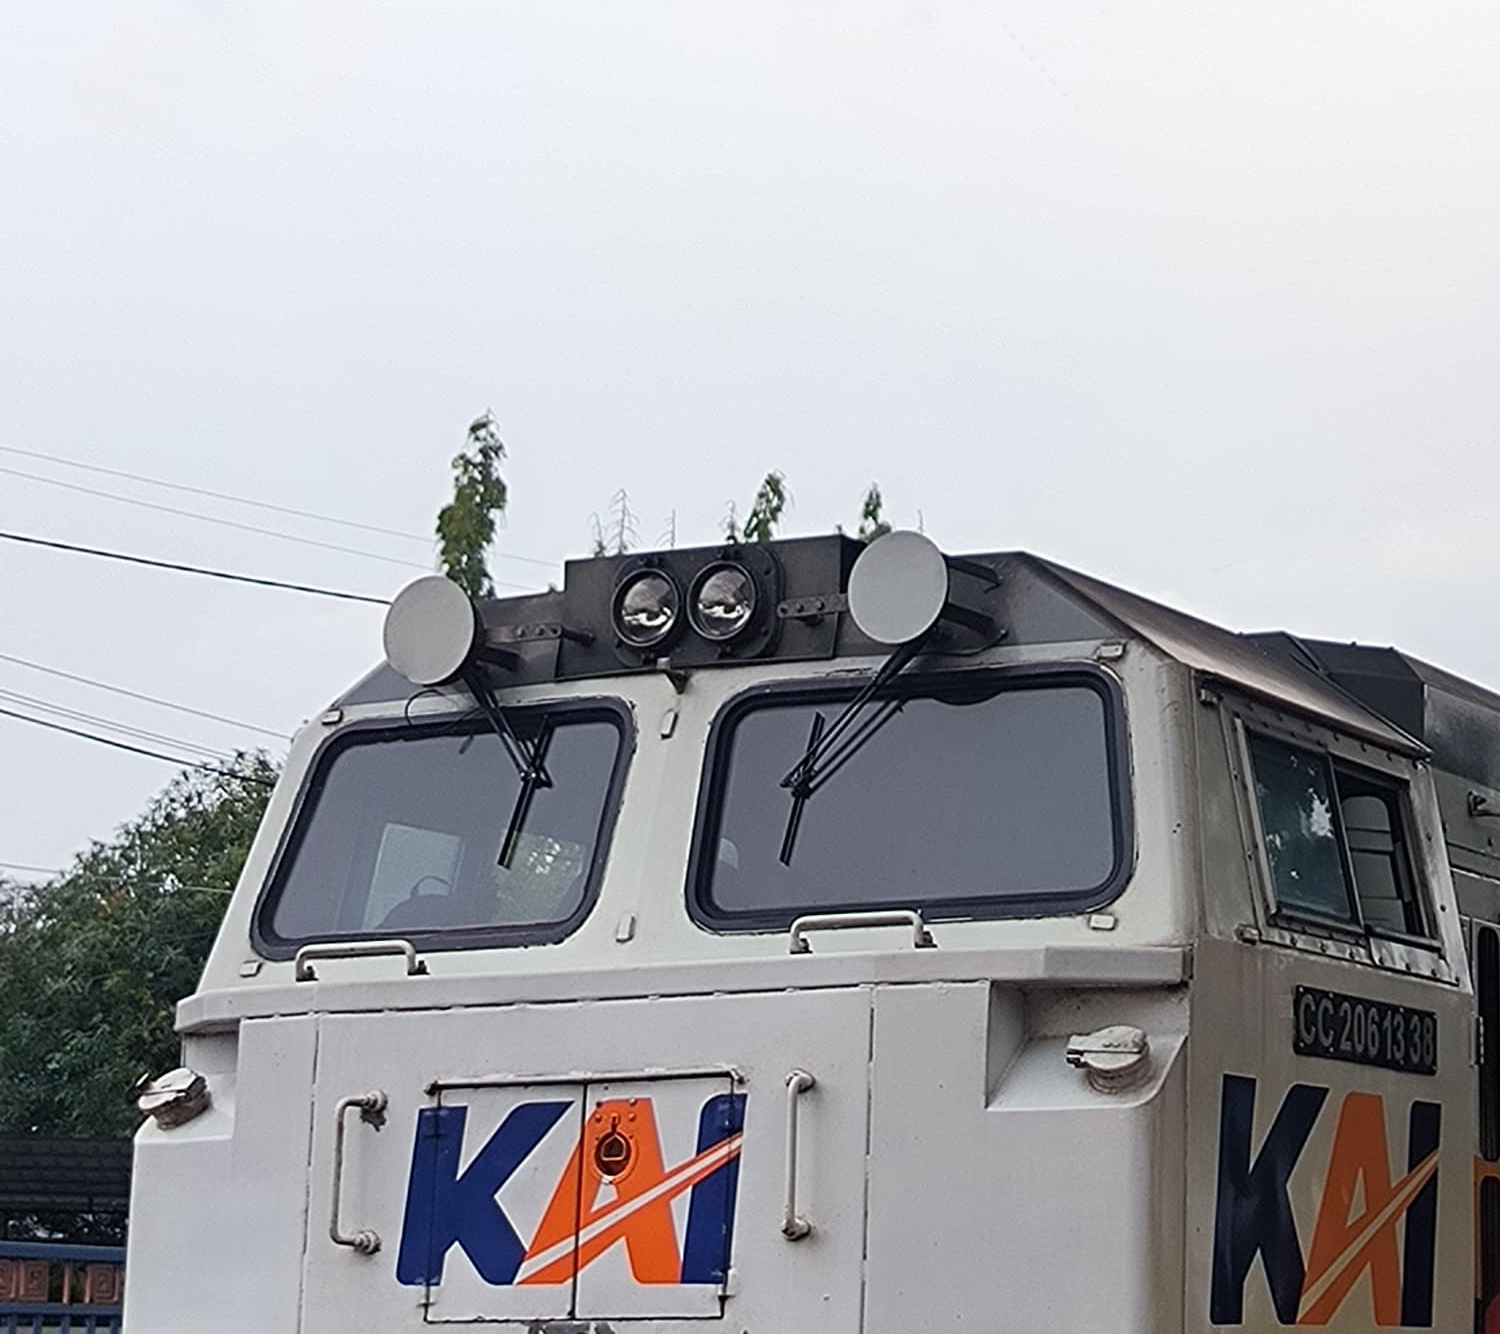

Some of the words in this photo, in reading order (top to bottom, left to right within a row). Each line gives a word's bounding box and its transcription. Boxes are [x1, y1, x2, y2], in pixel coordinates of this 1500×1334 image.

[1299, 993, 1334, 1048] CC
[1338, 1000, 1381, 1059] 206
[395, 1093, 748, 1287] KAI
[1209, 1073, 1442, 1327] KAI
